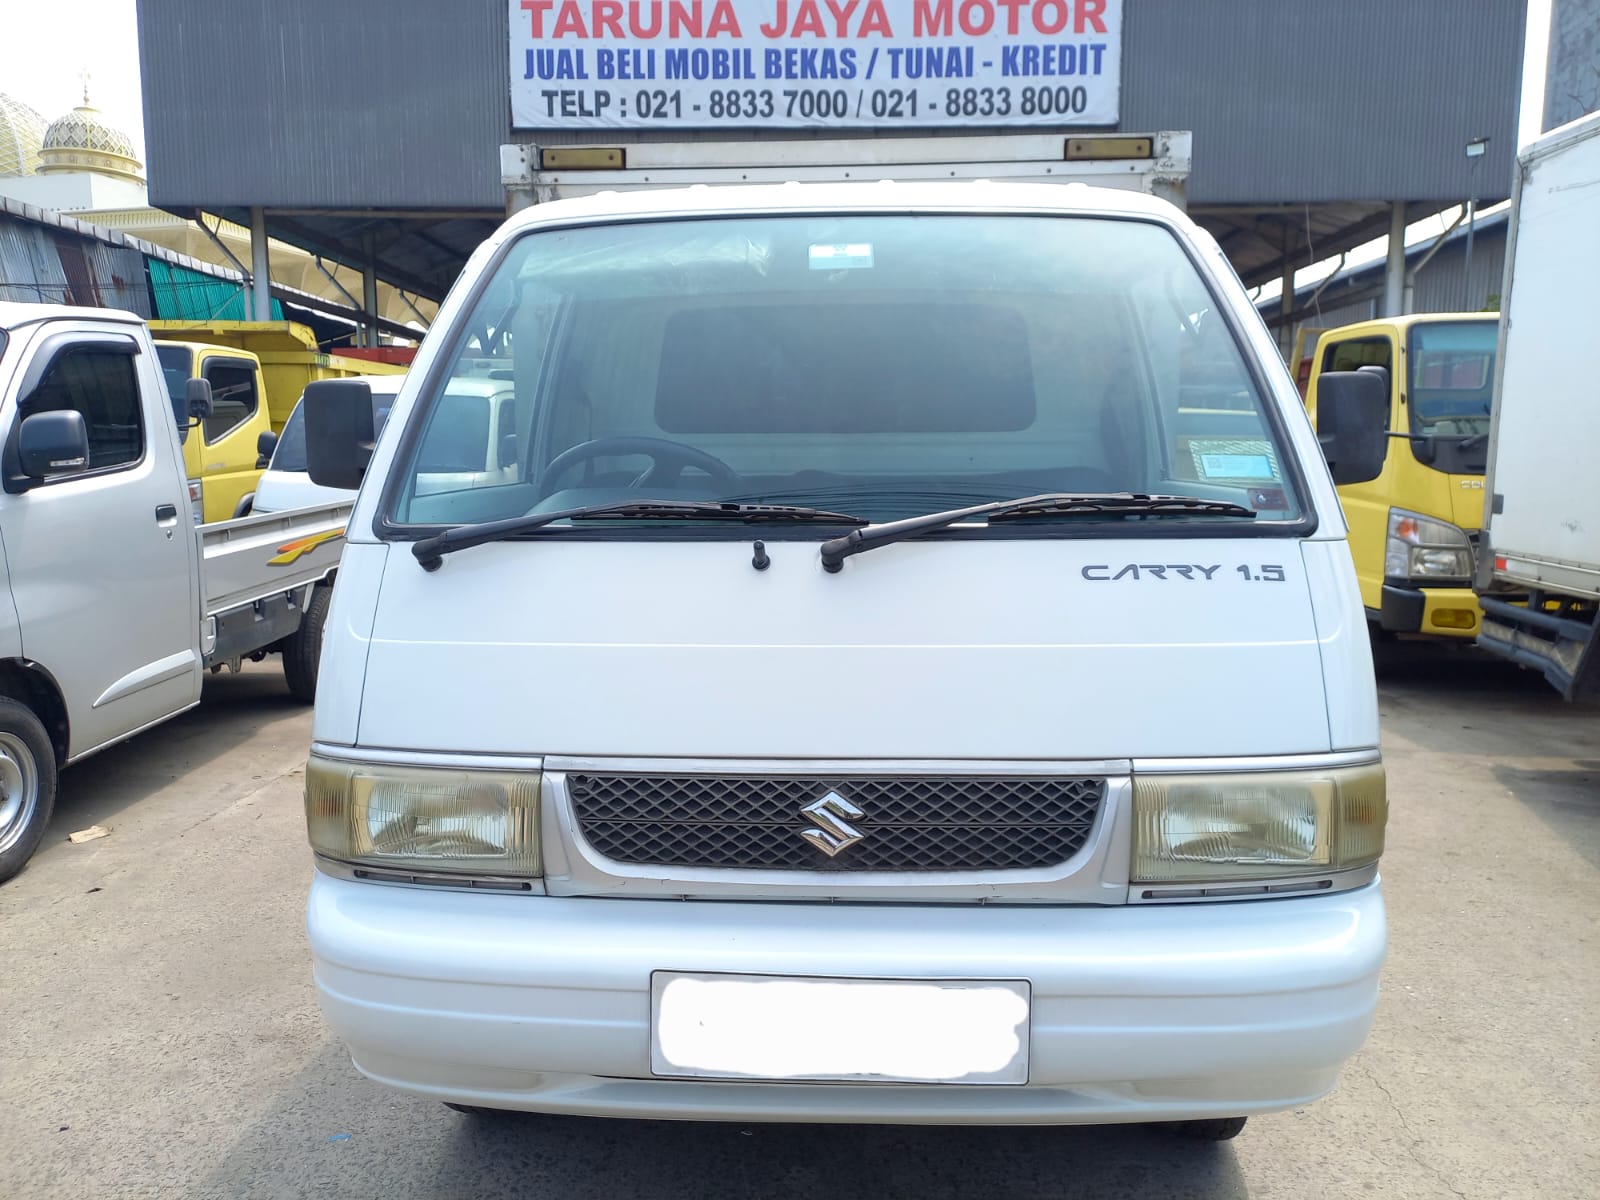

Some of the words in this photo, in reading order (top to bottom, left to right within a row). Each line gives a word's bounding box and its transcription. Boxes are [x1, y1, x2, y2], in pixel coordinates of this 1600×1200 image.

[520, 0, 742, 39] TARUNA
[759, 0, 893, 39] JAYA
[913, 0, 1108, 37] MOTOR
[523, 48, 589, 80] JUAL
[597, 48, 655, 80] BELI
[664, 48, 756, 80] MOBIL
[764, 47, 857, 80] BEKAS
[865, 47, 879, 80] /
[887, 46, 974, 79] TUNAI
[1001, 44, 1107, 77] KREDIT
[541, 90, 611, 118] TELP
[635, 90, 682, 118] 021
[709, 90, 774, 118] 8833
[783, 89, 848, 118] 7000
[856, 89, 864, 118] /
[871, 89, 918, 117] 021
[945, 87, 1011, 117] 8833
[1020, 86, 1087, 116] 8000
[1081, 564, 1222, 581] CARRY
[1236, 564, 1286, 582] 1.5
